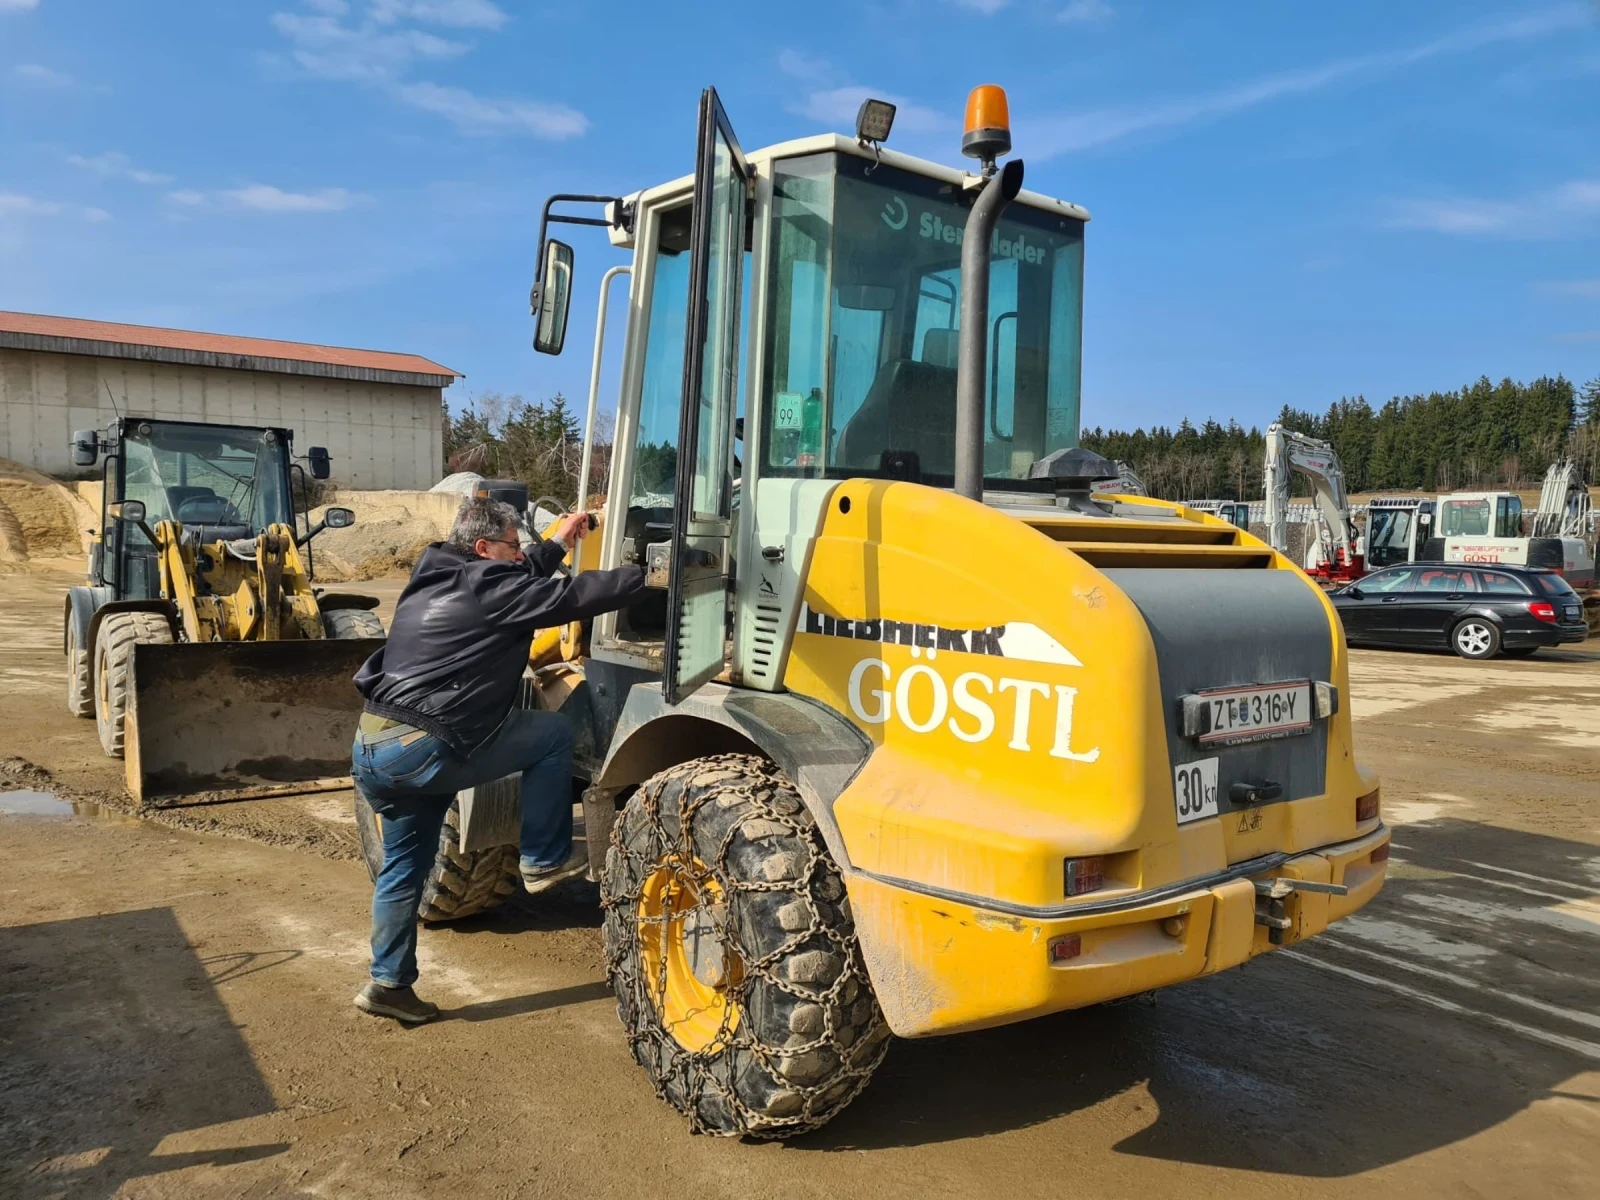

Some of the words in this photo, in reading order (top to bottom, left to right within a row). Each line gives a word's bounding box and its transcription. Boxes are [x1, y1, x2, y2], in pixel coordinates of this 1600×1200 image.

[780, 408, 793, 425] 99
[847, 645, 1100, 764] GÖSTL
[1178, 767, 1203, 816] 30
